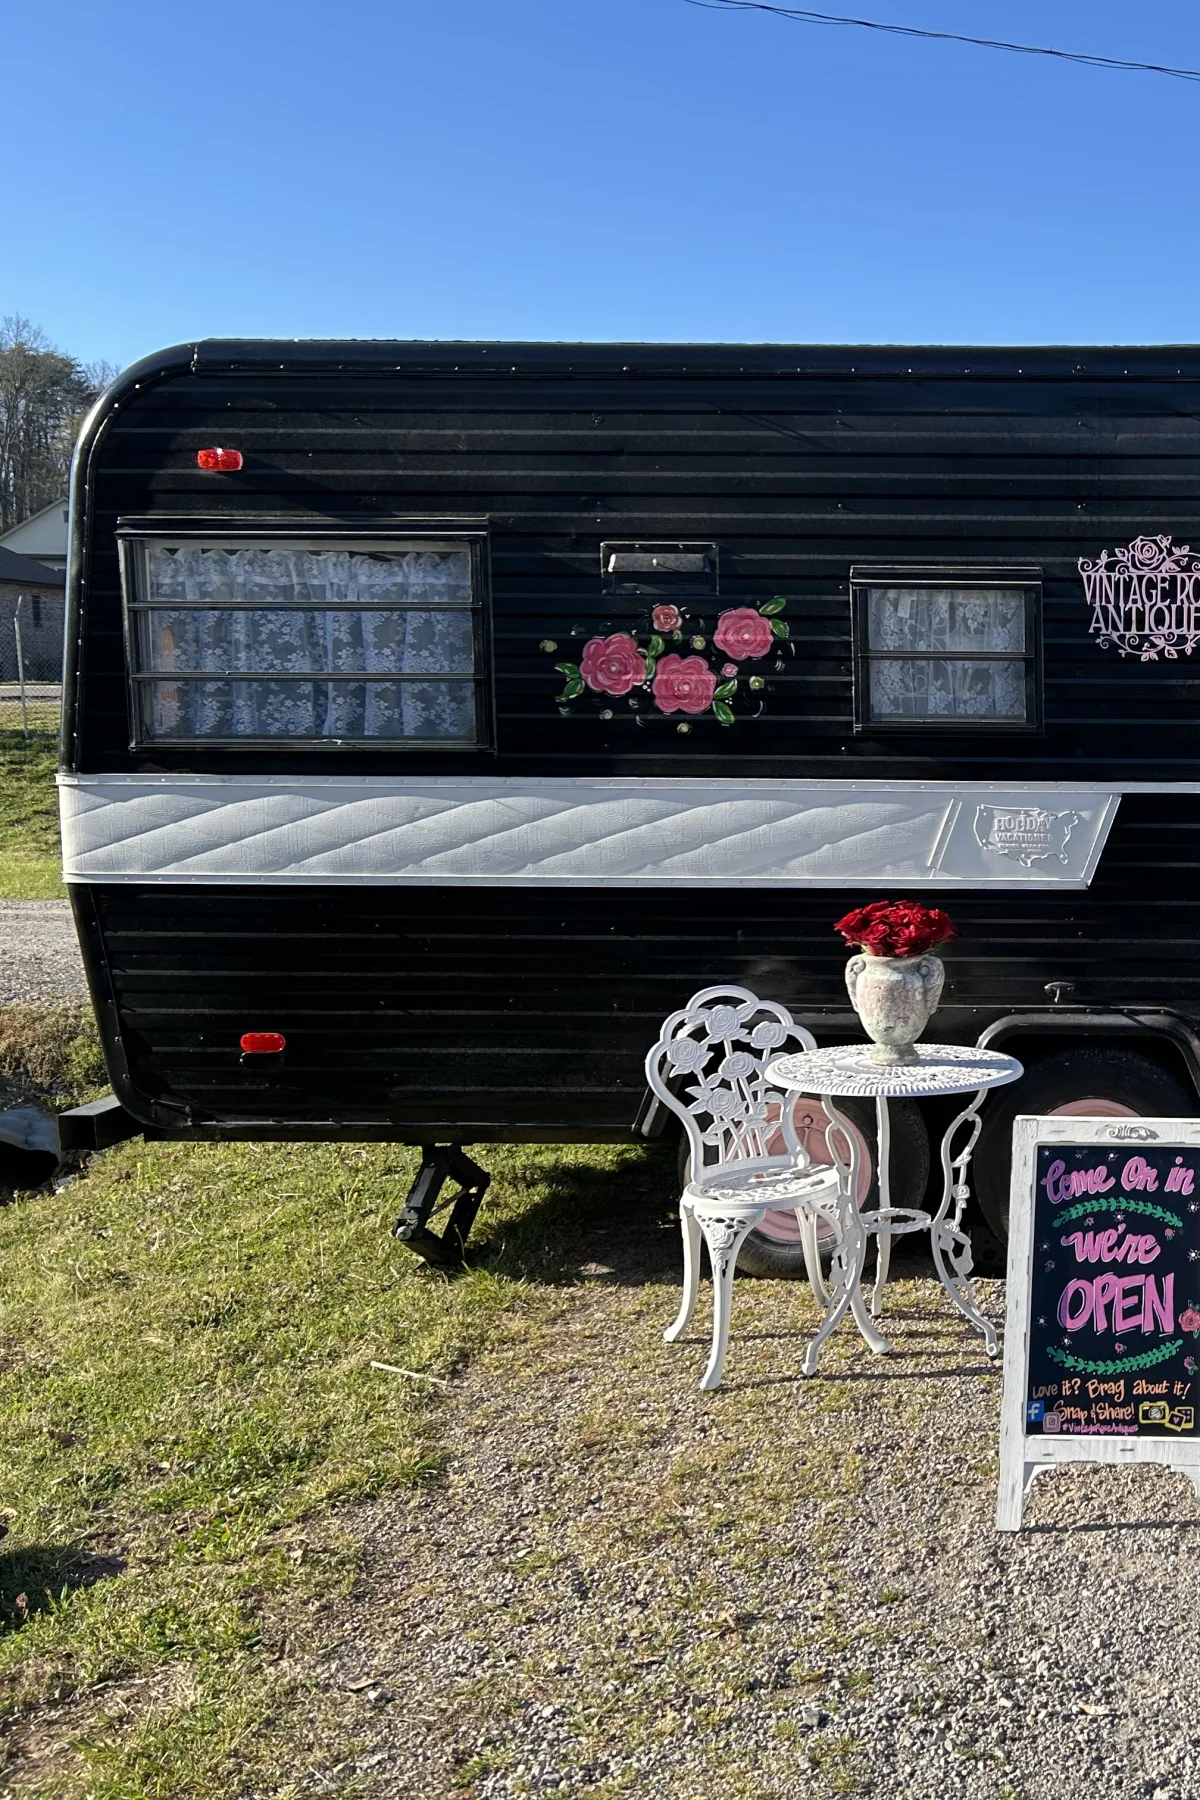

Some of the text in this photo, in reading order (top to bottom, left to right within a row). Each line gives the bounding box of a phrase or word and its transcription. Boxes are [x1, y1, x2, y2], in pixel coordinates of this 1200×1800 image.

[1081, 573, 1171, 606] VINTAGE
[993, 814, 1057, 832] HOLIDAY
[994, 833, 1053, 842] VACATIONER
[1040, 1156, 1195, 1203] Come On in
[1060, 1222, 1161, 1264] we're
[1057, 1272, 1175, 1337] OPEN
[1061, 1378, 1081, 1396] it?
[1085, 1378, 1125, 1402] Brag
[1132, 1379, 1170, 1396] about
[1173, 1381, 1191, 1400] it!
[1053, 1400, 1088, 1425] Snap
[1096, 1402, 1135, 1420] Share!
